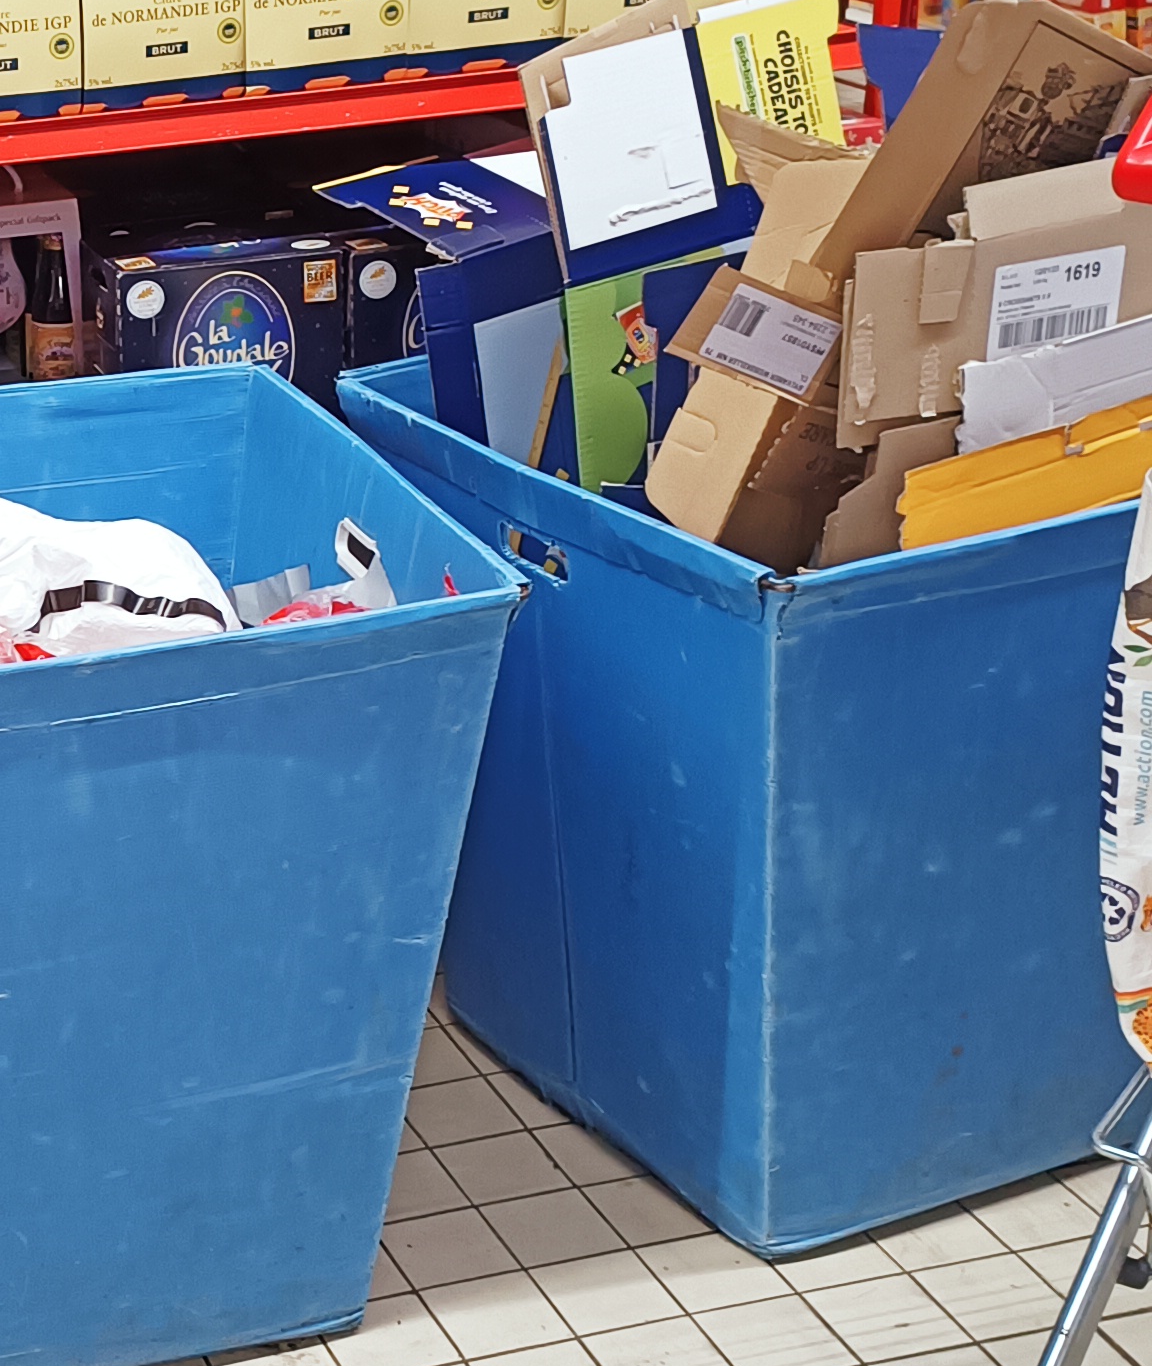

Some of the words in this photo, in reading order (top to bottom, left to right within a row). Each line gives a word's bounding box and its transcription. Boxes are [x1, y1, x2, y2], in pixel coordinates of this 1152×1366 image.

[44, 15, 72, 31] IGP
[111, 3, 209, 25] NORMANDIE
[214, 0, 241, 14] IGP
[775, 29, 806, 111] CHOISIS
[1065, 261, 1102, 283] 1619
[208, 319, 229, 344] la
[178, 331, 290, 371] Goudale
[1133, 689, 1152, 827] www.action.com
